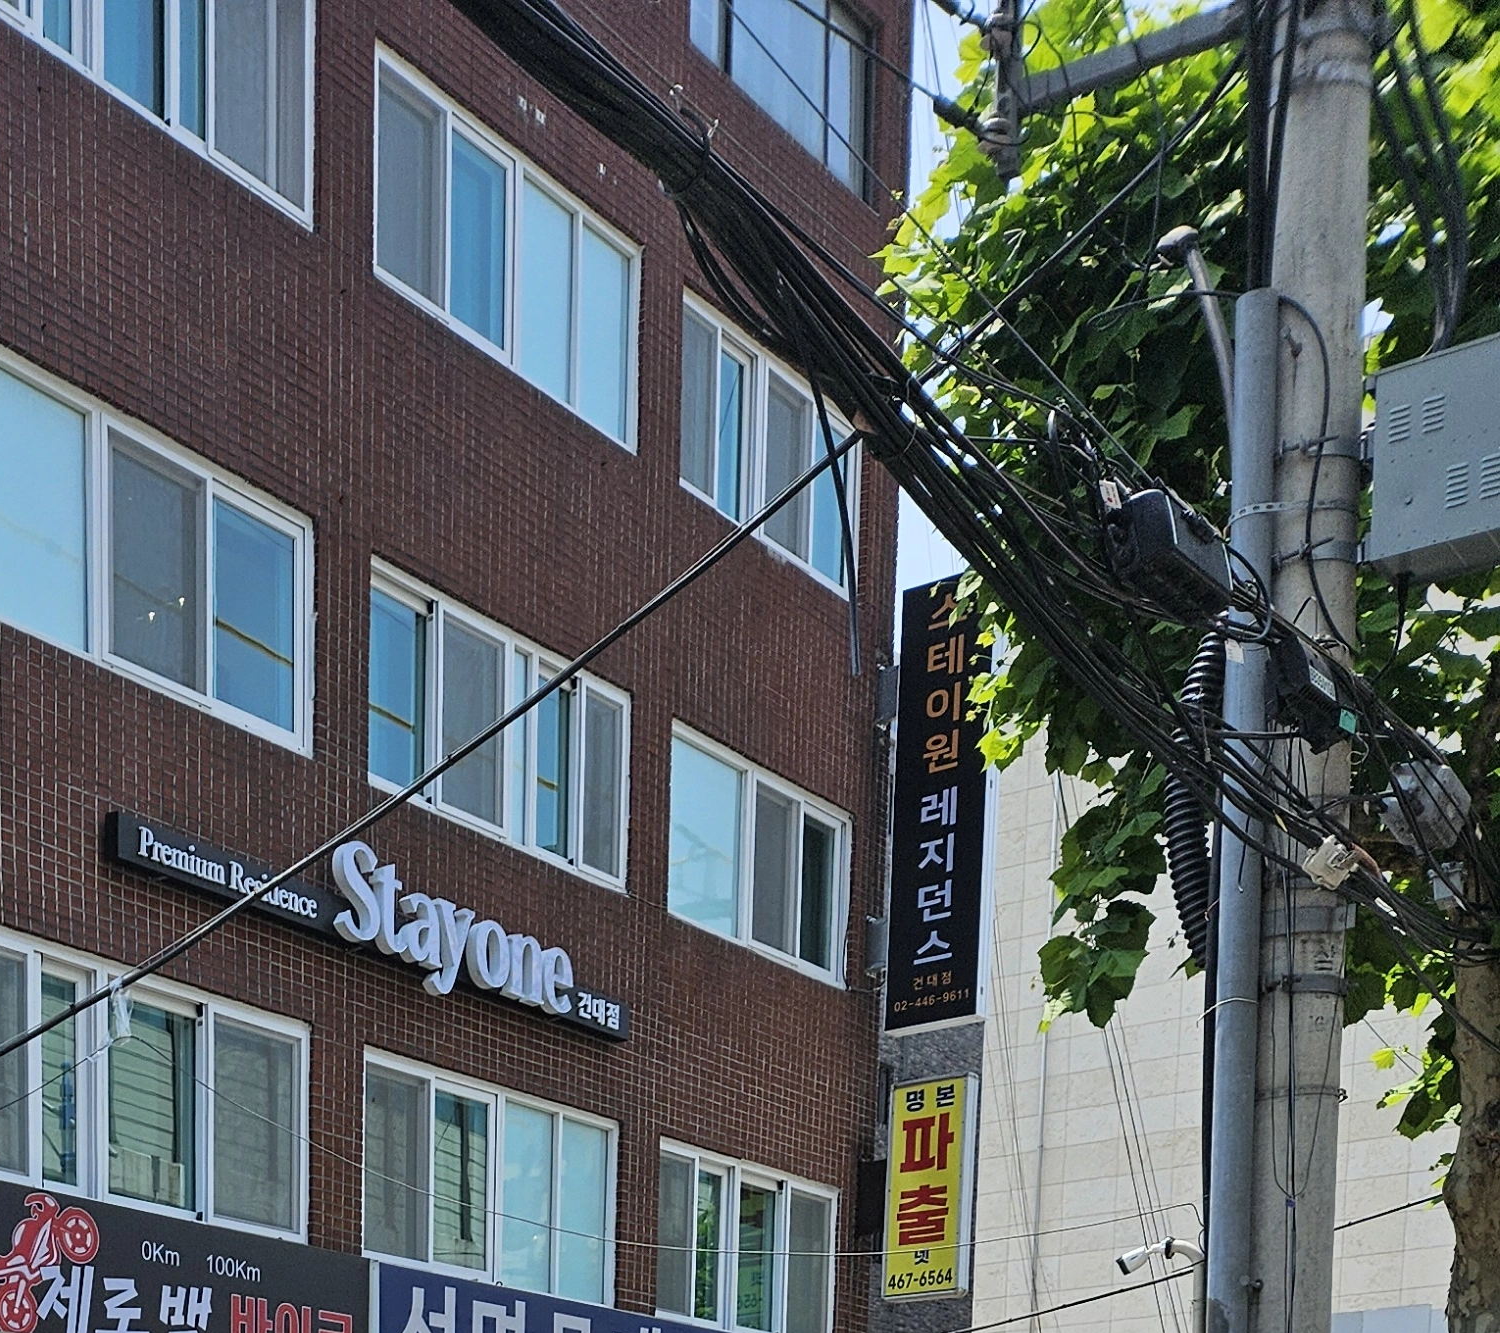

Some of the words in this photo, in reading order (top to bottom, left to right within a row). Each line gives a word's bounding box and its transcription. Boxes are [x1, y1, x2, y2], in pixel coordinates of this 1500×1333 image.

[137, 826, 226, 885] Premium
[913, 785, 958, 967] 레지던스
[331, 840, 575, 1015] Stayone
[894, 988, 970, 1012] 02-446-9611
[913, 970, 952, 991] 건대점
[577, 990, 622, 1031] 건대점
[897, 1111, 955, 1247] 파출
[141, 1240, 181, 1268] 0Km
[206, 1253, 261, 1282] 100Km
[887, 1267, 953, 1291] 467-6564
